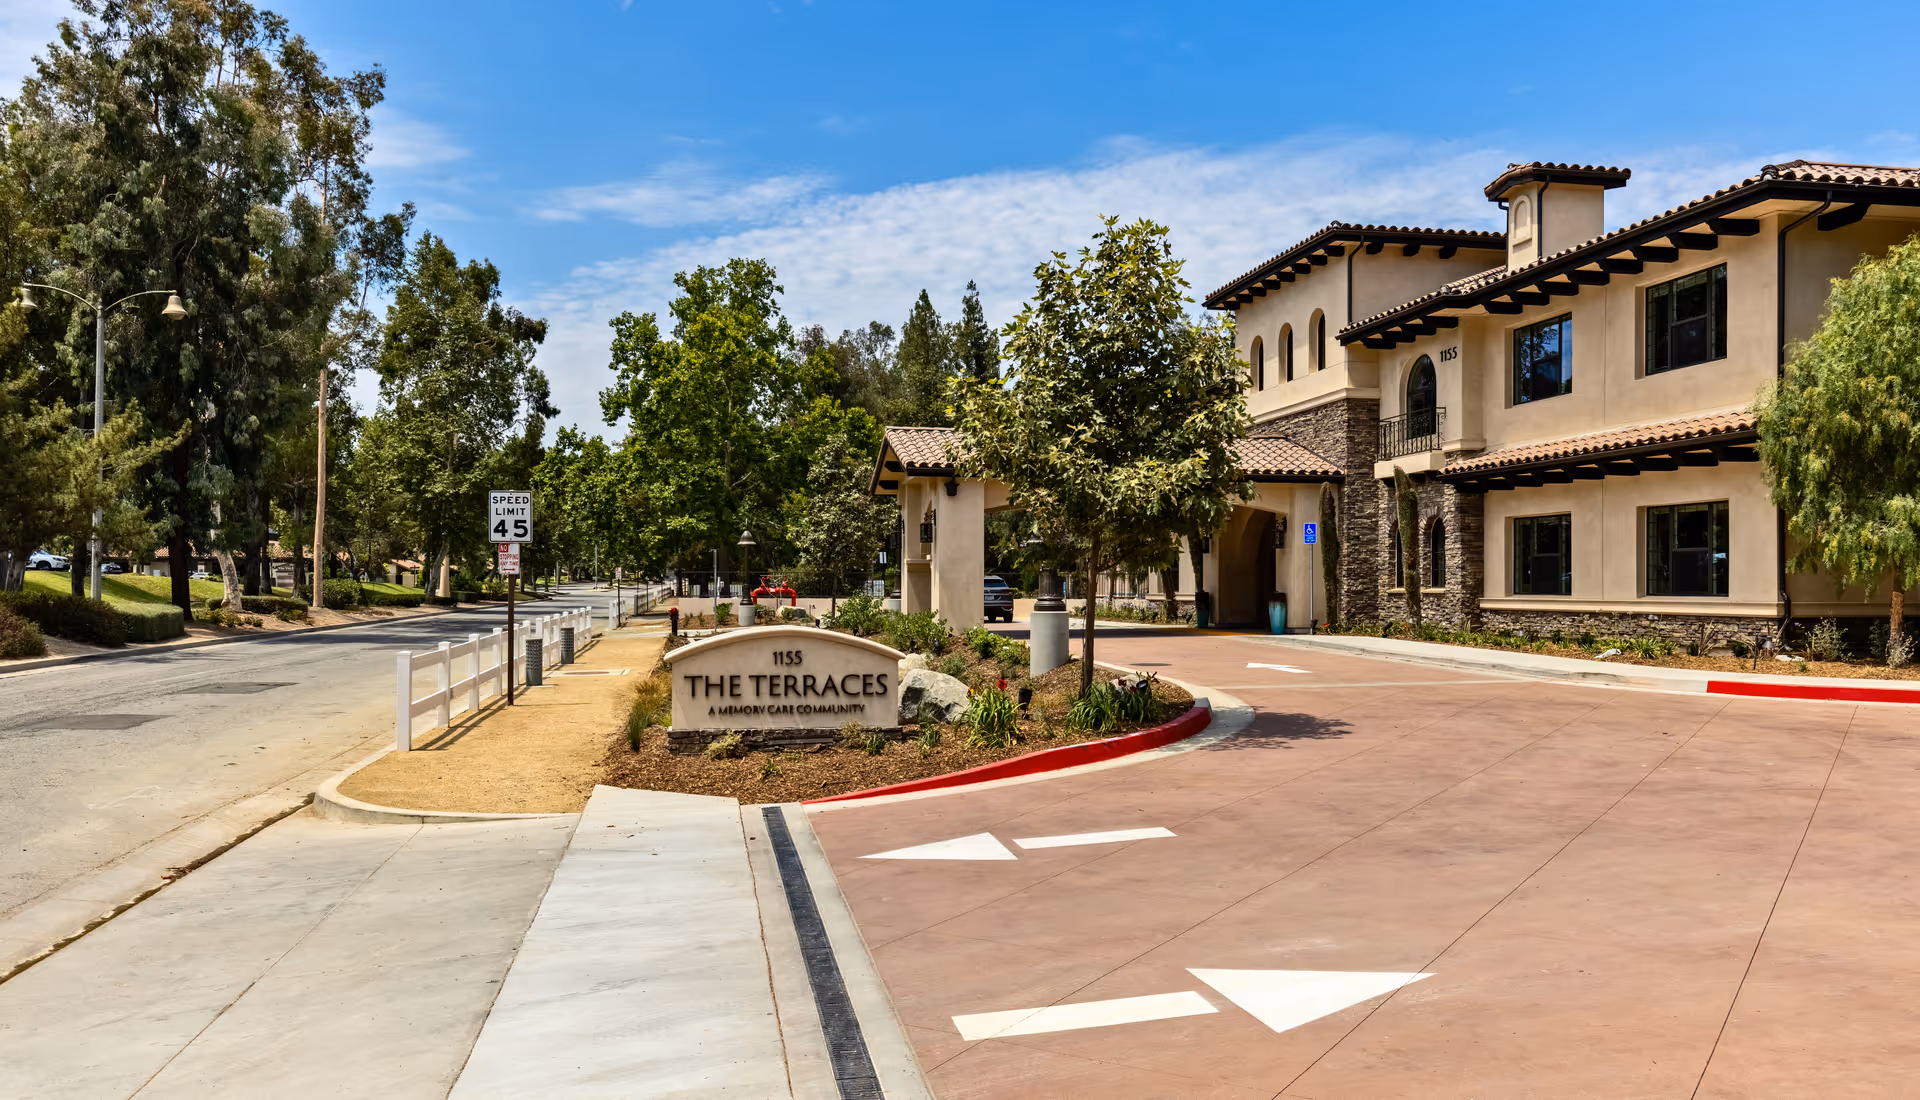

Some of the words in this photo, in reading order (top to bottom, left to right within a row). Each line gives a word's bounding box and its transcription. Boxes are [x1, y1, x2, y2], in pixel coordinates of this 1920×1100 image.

[1440, 346, 1458, 363] 1155
[492, 496, 529, 504] SPEED
[495, 507, 526, 516] LIMIT
[493, 519, 528, 538] 45
[500, 544, 508, 552] NO
[772, 650, 803, 666] 1155
[683, 675, 742, 698] THE
[748, 673, 889, 698] TERRACES
[708, 706, 716, 716] A
[718, 705, 766, 716] MEMORY
[767, 704, 794, 715] CARE
[796, 703, 866, 714] COMMUNITY
